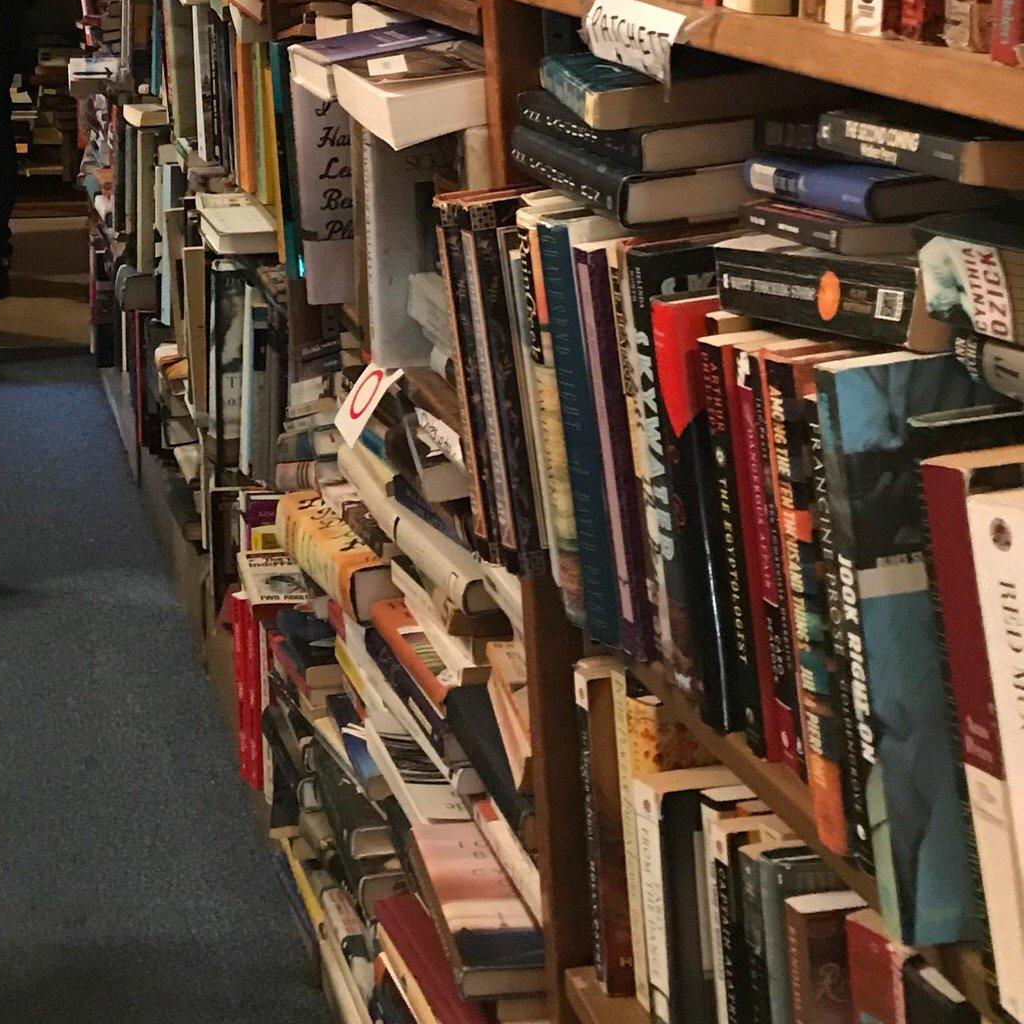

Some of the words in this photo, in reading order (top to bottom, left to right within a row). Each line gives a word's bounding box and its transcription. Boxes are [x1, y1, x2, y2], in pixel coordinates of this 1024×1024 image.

[961, 247, 989, 332] CYNTHIA
[976, 251, 1010, 337] OZICK
[708, 361, 726, 433] ARTHUR
[769, 384, 787, 445] AMONG
[632, 329, 676, 562] SKYWATER
[774, 447, 792, 478] THE
[717, 477, 732, 513] THE
[778, 480, 796, 510] TEN
[782, 510, 805, 593] THOUSAND
[807, 421, 833, 561] FRANCINE
[825, 572, 845, 656] PROSE
[720, 519, 748, 666] EGYPTOLOGIST
[792, 595, 812, 652] THINGS
[846, 631, 870, 719] RIGHT
[858, 721, 876, 763] ON
